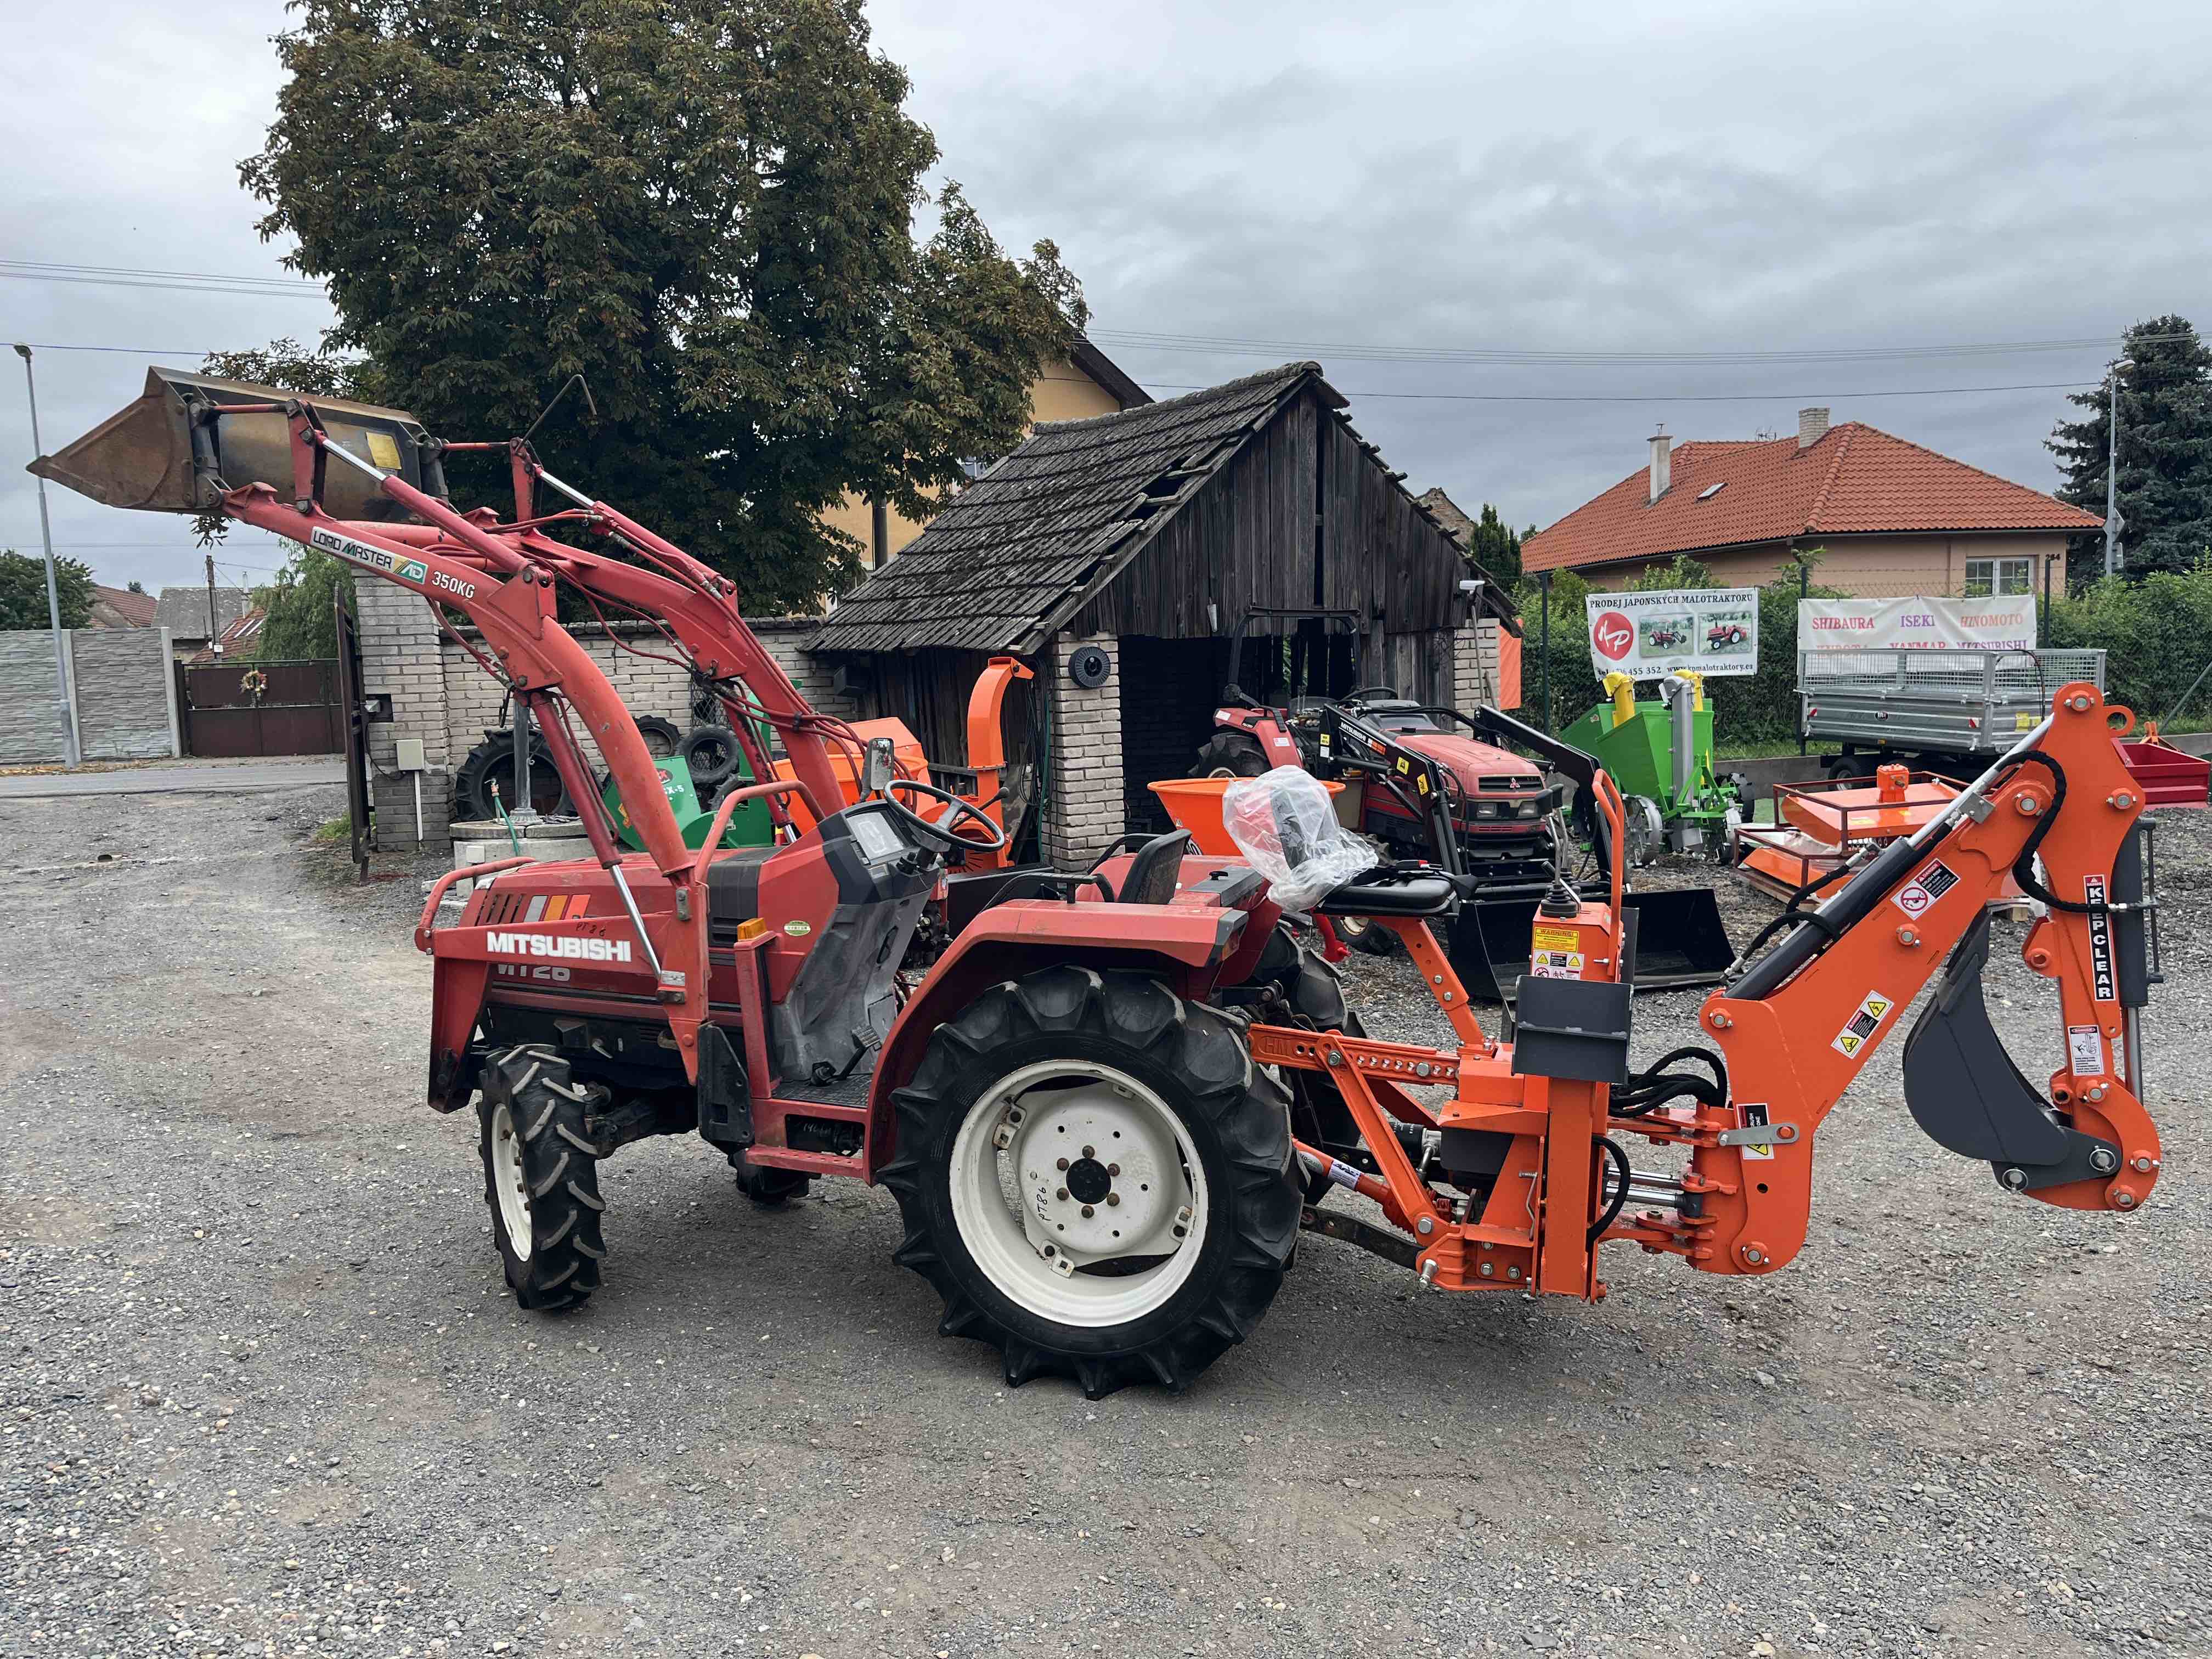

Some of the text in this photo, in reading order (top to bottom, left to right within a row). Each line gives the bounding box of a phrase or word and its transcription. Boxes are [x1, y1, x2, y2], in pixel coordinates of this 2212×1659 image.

[342, 541, 392, 569] MASTER
[432, 571, 476, 599] 350KG
[1590, 599, 1622, 608] PRODEJ
[1812, 613, 2024, 630] SHIBAURA ISEKI HINOMOTO
[1646, 667, 1662, 675] 352
[1340, 721, 1367, 742] MITSUBISHI
[487, 930, 632, 962] MITSUBISHI
[2093, 934, 2111, 997] CLEAR
